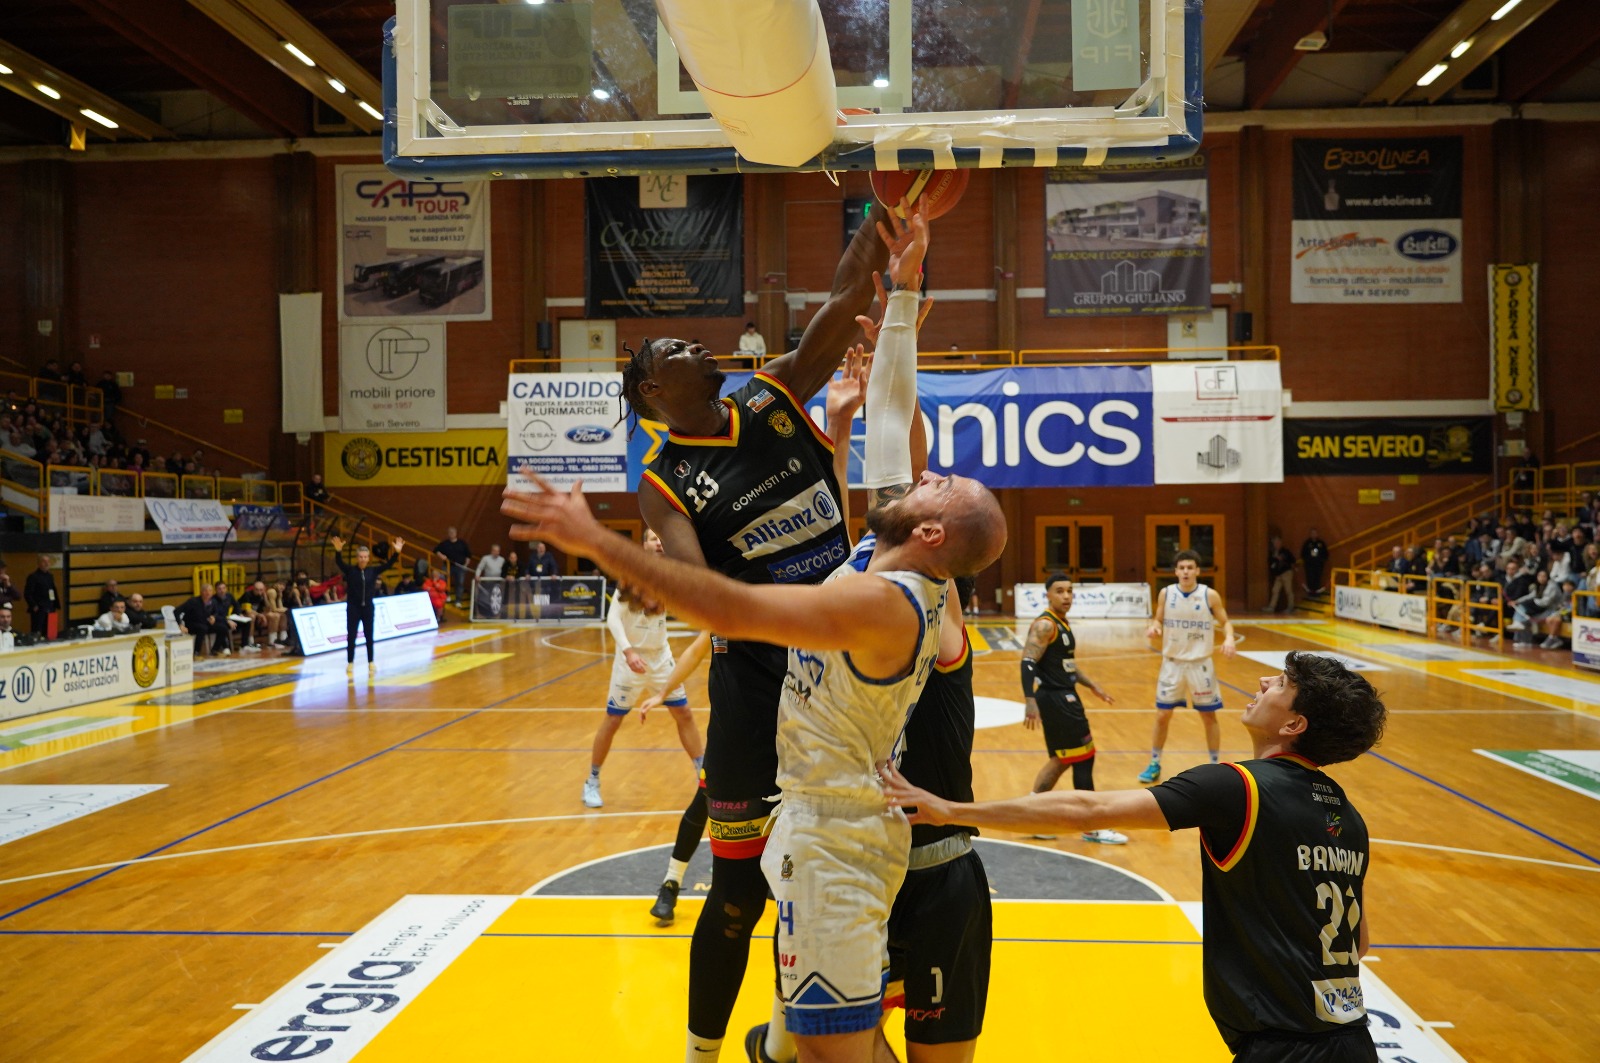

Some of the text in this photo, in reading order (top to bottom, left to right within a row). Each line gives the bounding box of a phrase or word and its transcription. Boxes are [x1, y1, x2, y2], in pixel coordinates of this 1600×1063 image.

[416, 200, 459, 213] TOUR
[1073, 291, 1188, 305] GRUPPO GIULIANO
[350, 386, 436, 401] mobili priore
[513, 381, 622, 399] CANDIDO
[525, 407, 610, 417] PLURIMARCHE
[572, 427, 605, 442] Ford
[1297, 434, 1425, 459] SAN SEVERO
[385, 447, 500, 468] CESTISTICA
[686, 471, 719, 513] 13
[732, 475, 780, 511] GOMMISTI
[741, 508, 817, 550] Allianz
[785, 542, 845, 577] euronics
[63, 655, 119, 678] PAZIENZA
[64, 672, 120, 693] assicurazioni
[411, 942, 438, 957] per
